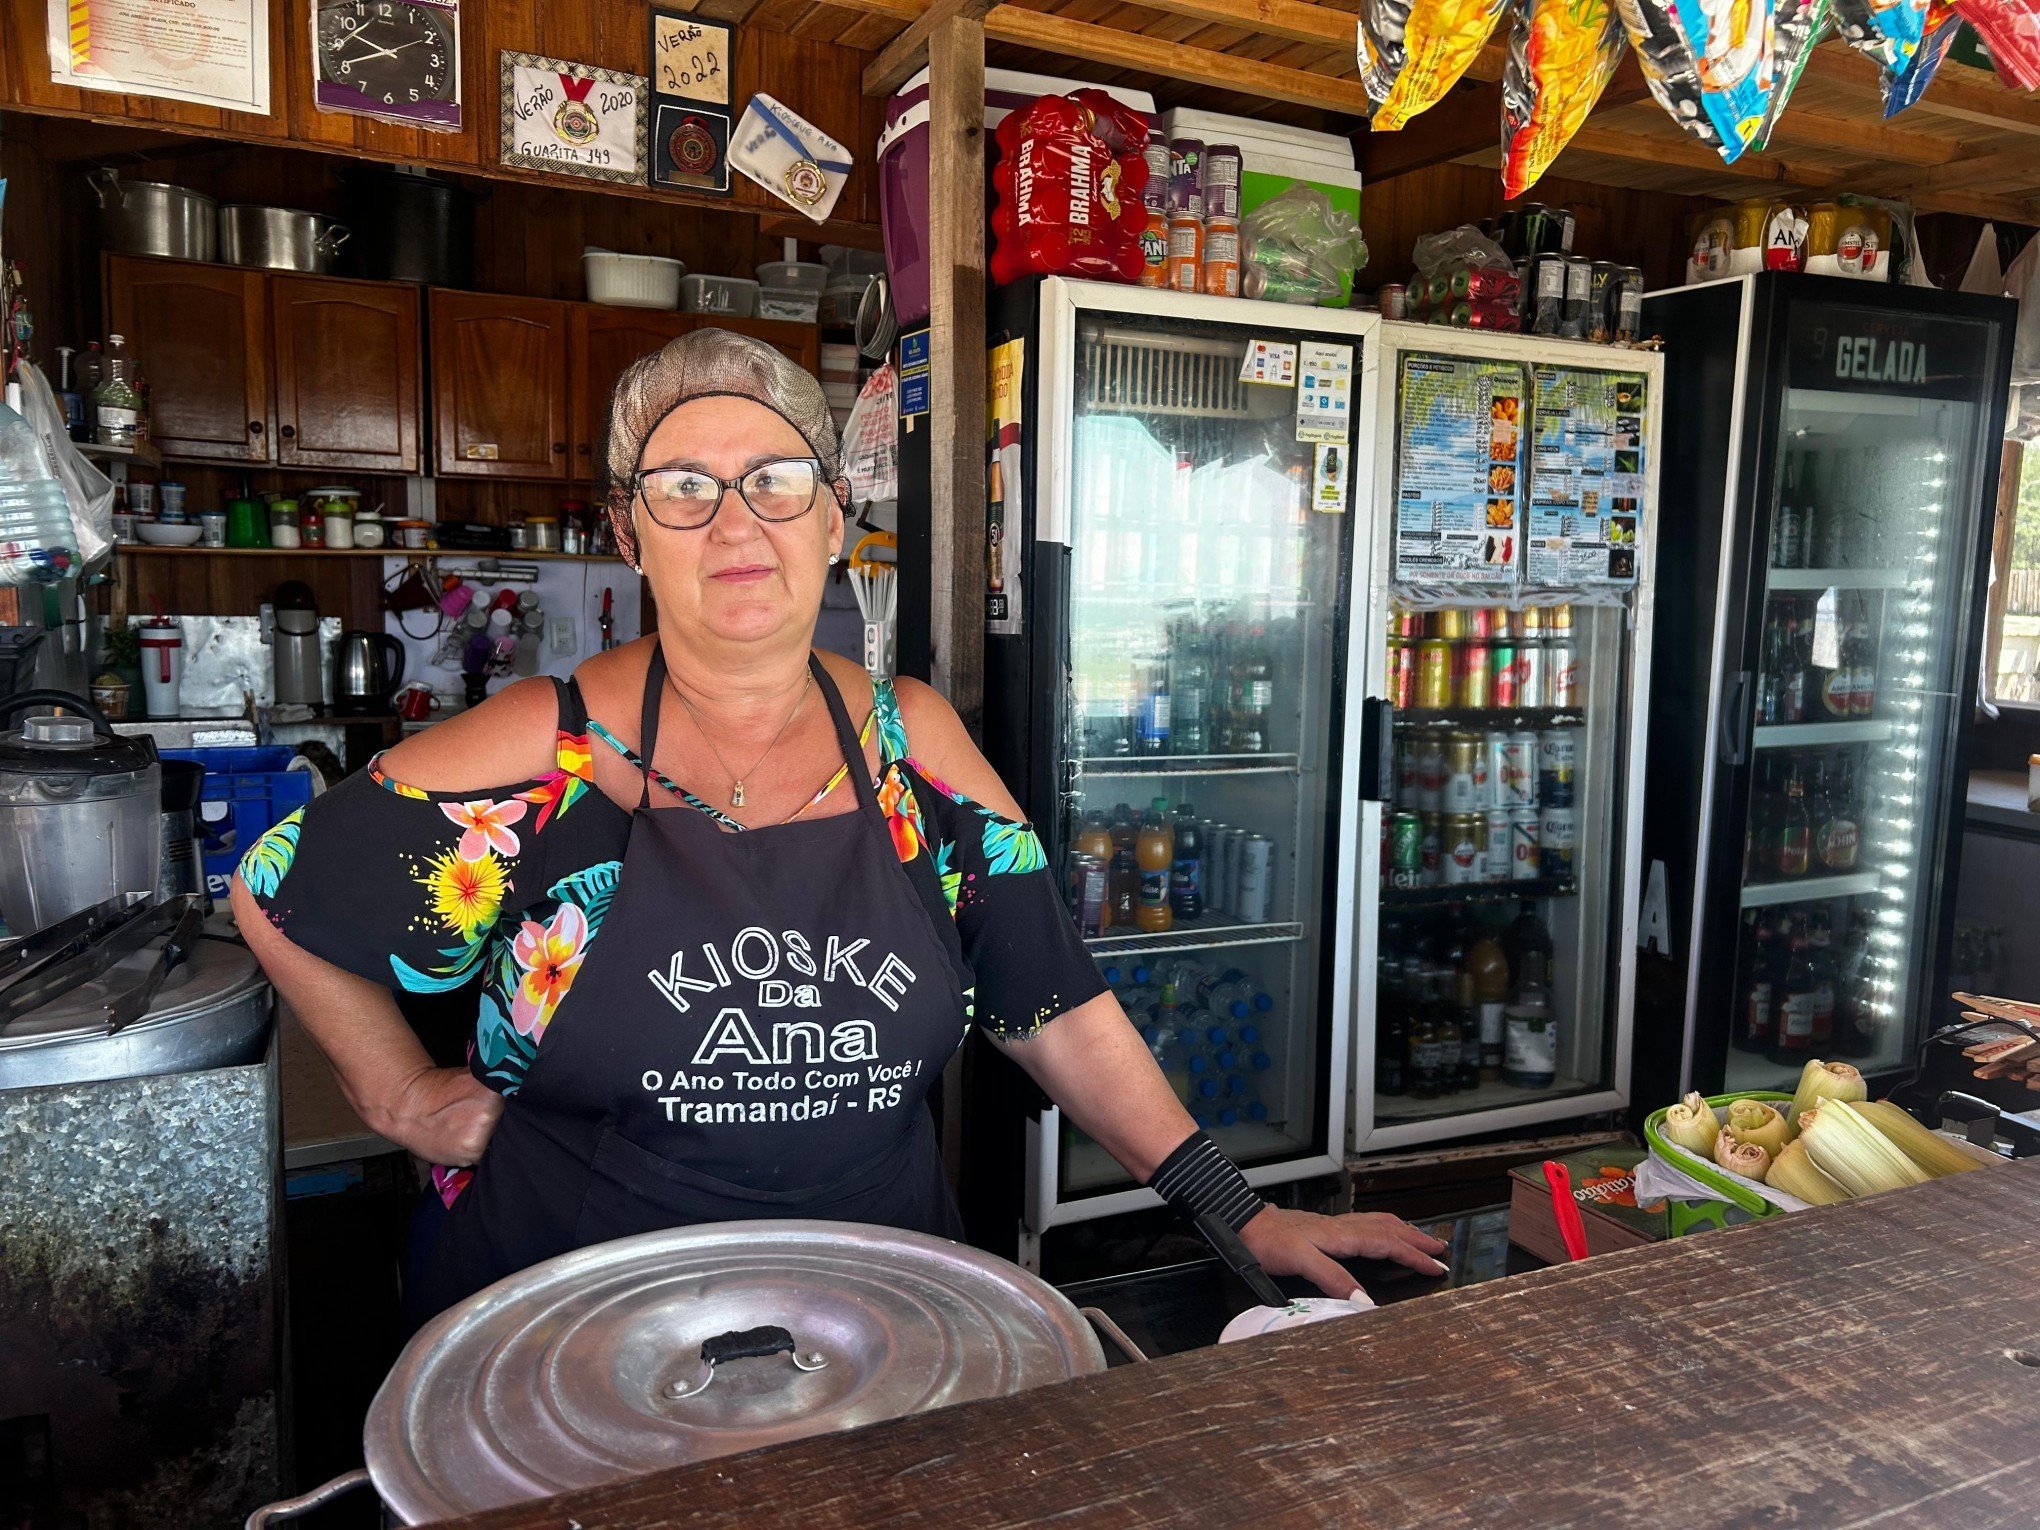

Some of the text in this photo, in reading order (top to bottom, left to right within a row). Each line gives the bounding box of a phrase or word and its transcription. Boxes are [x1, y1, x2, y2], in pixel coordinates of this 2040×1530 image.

[148, 0, 196, 8] RTIFICADO
[356, 2, 365, 16] 11
[378, 3, 392, 18] 12
[340, 16, 357, 31] 10
[408, 11, 414, 24] 1
[424, 30, 434, 45] 2
[658, 24, 702, 52] VERÃO
[340, 61, 351, 74] 8
[429, 53, 440, 68] 3
[663, 51, 721, 89] 2022
[358, 80, 367, 93] 7
[425, 74, 435, 88] 4
[383, 92, 394, 105] 6
[409, 88, 419, 102] 5
[514, 83, 633, 121] VERÃO 2020
[521, 141, 611, 165] GUARITA 149
[1018, 138, 1035, 227] BRAHMA
[1068, 145, 1092, 226] BRAHMA
[1835, 335, 1926, 384] GELADA
[647, 926, 917, 1013] KIOSKE
[758, 980, 822, 1008] Da
[690, 1007, 880, 1066] Ana
[641, 1070, 663, 1091] O
[669, 1070, 724, 1091] Ano
[732, 1070, 796, 1091] Todo
[804, 1069, 859, 1090] Com
[657, 1092, 841, 1124] Tramandaí
[867, 1083, 903, 1113] RS
[1572, 1176, 1636, 1202] ratidão
